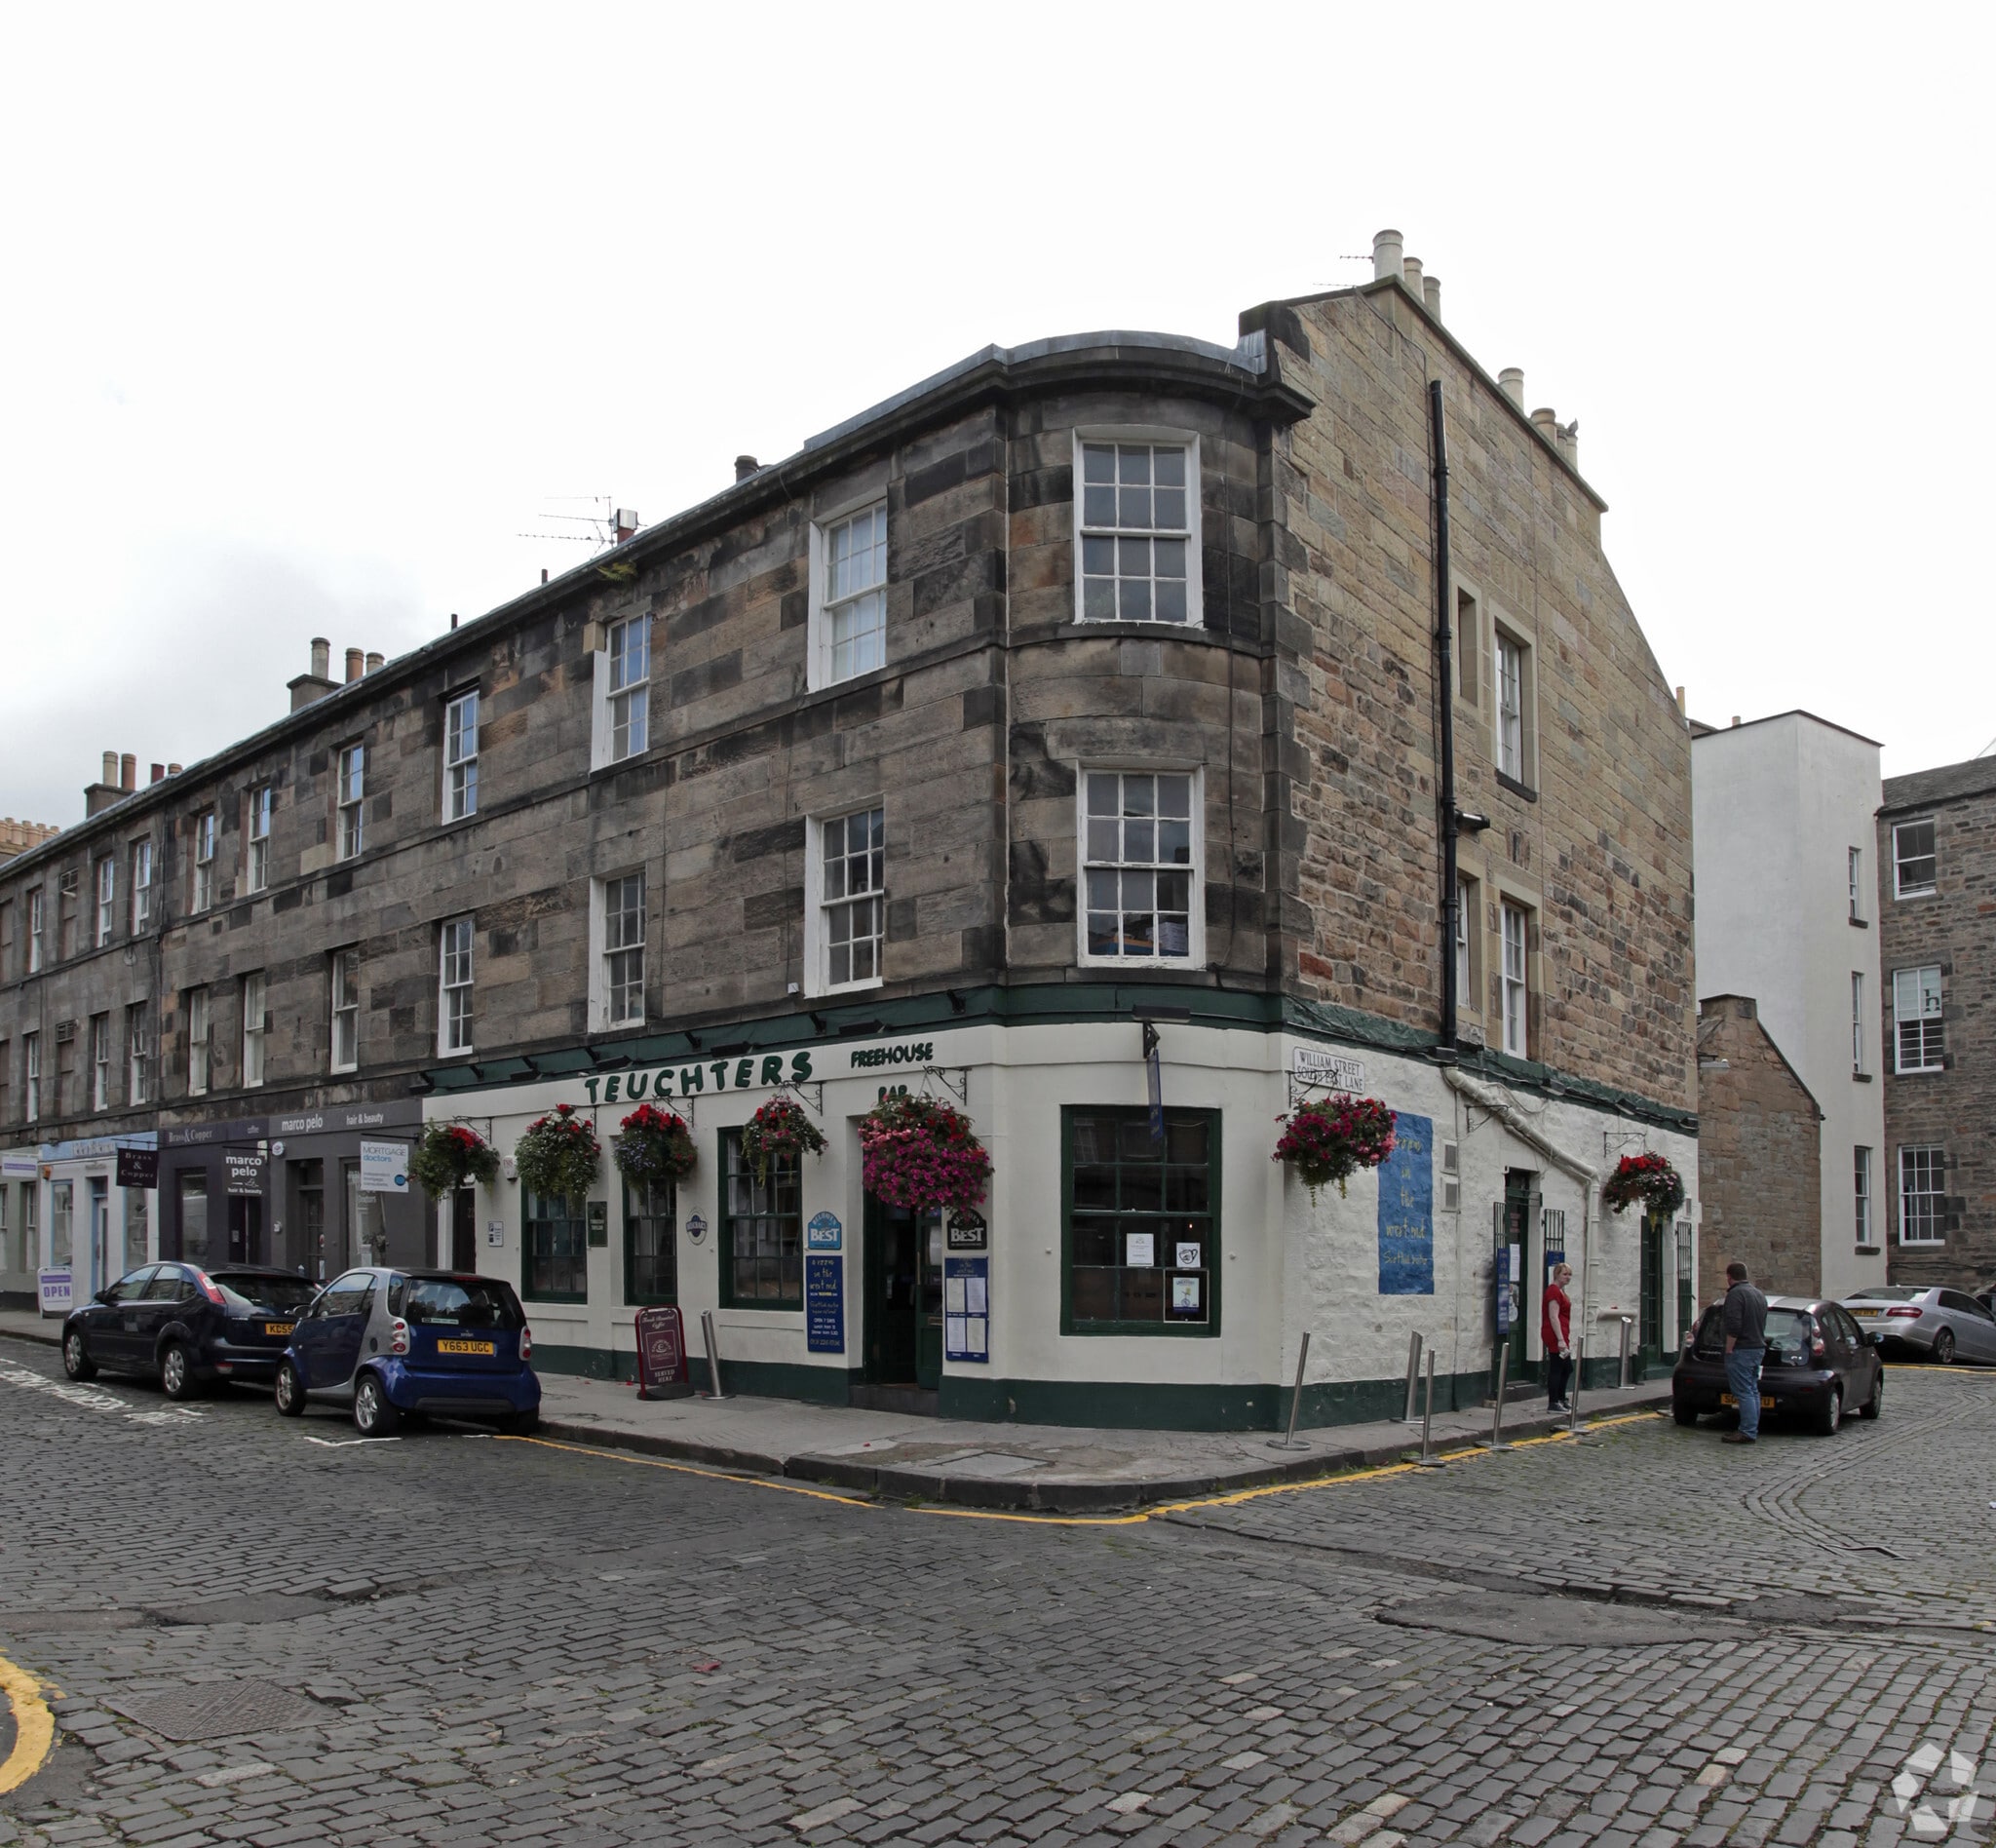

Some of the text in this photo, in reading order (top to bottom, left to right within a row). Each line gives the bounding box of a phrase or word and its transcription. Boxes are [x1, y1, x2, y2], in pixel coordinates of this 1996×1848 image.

[850, 1041, 934, 1069] FREEHOUSE
[1299, 1051, 1361, 1077] WILLIAM STREET
[584, 1051, 813, 1104] TEUCHTERS
[1345, 1075, 1363, 1092] LANE
[281, 1113, 324, 1133] marco pelo
[346, 1112, 384, 1126] hair & beauty
[363, 1145, 406, 1156] MORTGAGE
[225, 1155, 262, 1166] marco
[363, 1154, 392, 1163] doctors
[134, 1161, 142, 1170] &
[231, 1167, 257, 1177] pelo
[121, 1170, 154, 1178] Copper
[810, 1228, 840, 1242] BEST
[950, 1227, 984, 1242] BEST
[43, 1286, 70, 1297] OPEN
[442, 1340, 489, 1353] Y663 UGC
